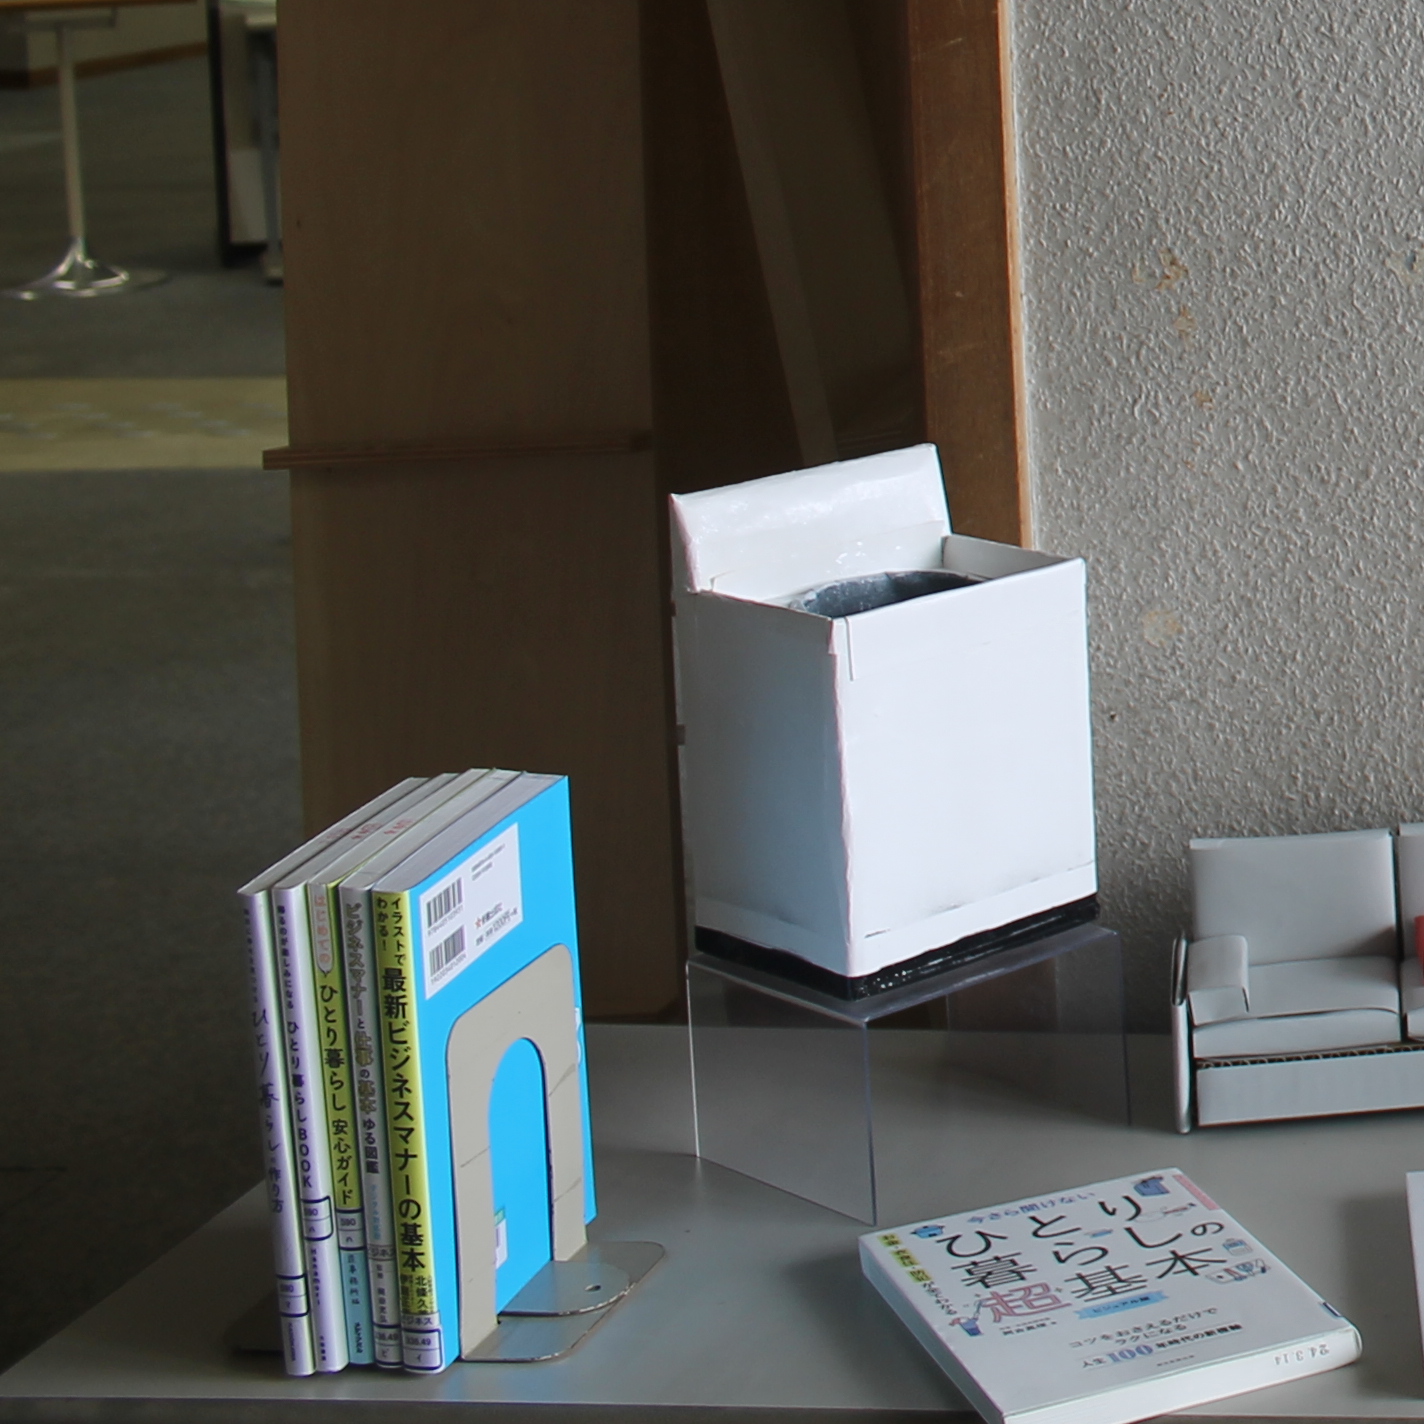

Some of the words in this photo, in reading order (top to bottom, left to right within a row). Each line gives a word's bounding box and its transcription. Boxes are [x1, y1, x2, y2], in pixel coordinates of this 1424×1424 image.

[313, 895, 332, 964] はじめての
[376, 897, 390, 952] わかる!
[390, 897, 408, 968] イラストで
[287, 1020, 314, 1189] ひとり暮らしBOOK
[319, 984, 353, 1206] ひとり暮らし安心ガイド
[381, 967, 427, 1273] 最新ビジネスマナーの基本
[934, 1195, 1144, 1259] ひとり
[967, 1192, 1093, 1224] 今さら聞けない
[953, 1221, 1223, 1288] 暮らしの
[977, 1248, 1226, 1321] 超基本
